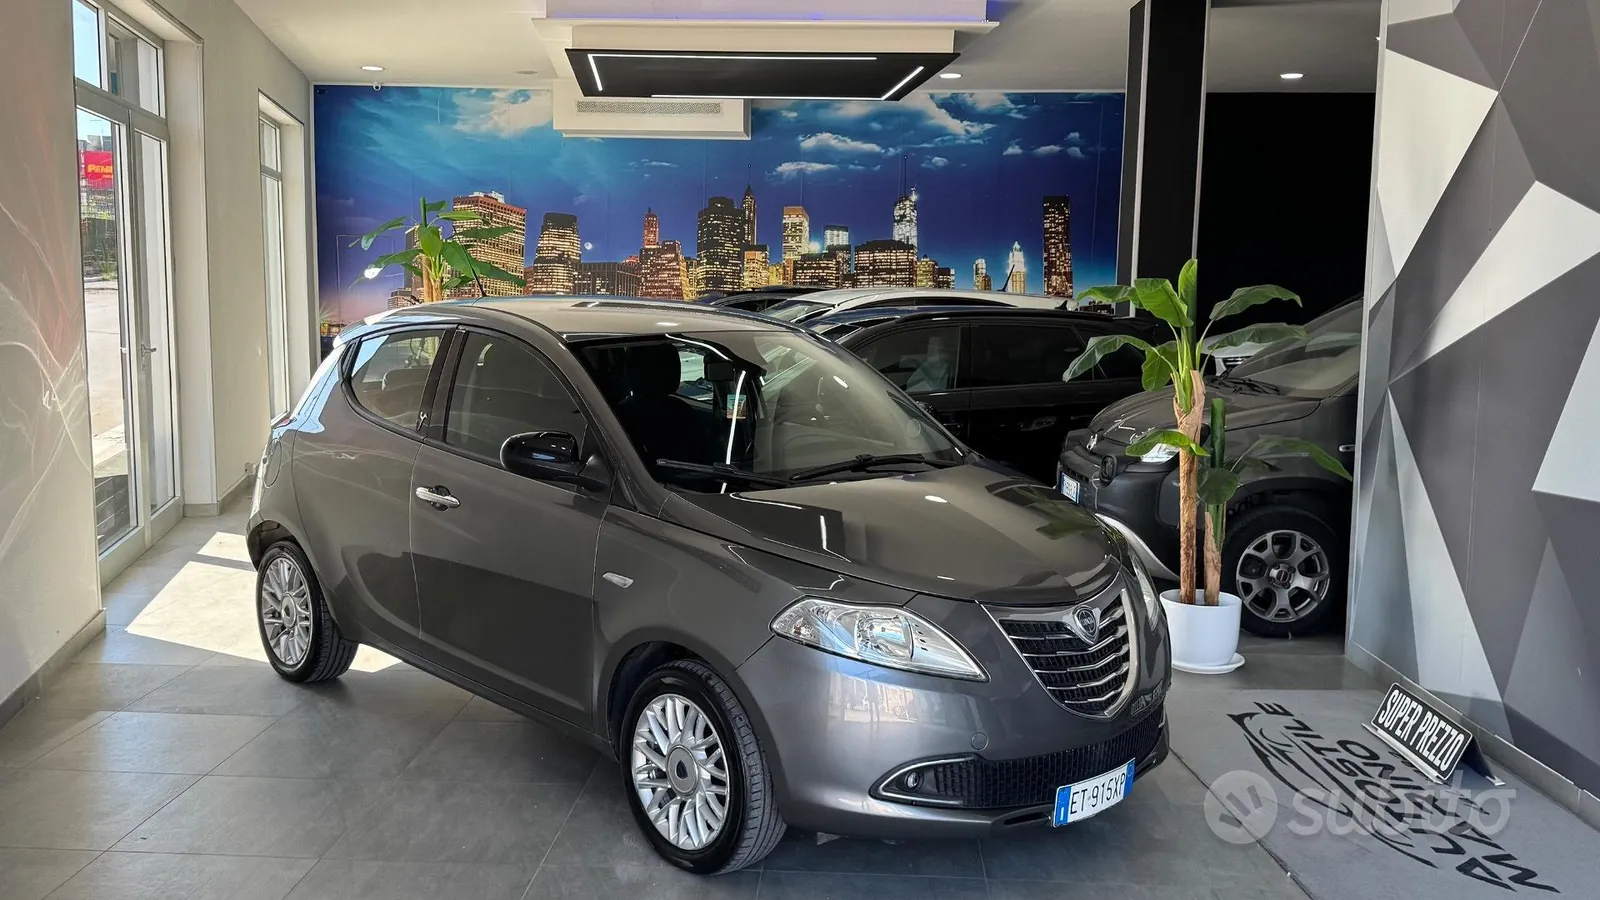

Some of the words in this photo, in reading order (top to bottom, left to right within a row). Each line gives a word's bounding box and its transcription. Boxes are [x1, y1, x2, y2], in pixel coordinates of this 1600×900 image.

[1253, 701, 1518, 892] AUTOSTILE
[1378, 689, 1423, 742] SUPER
[1409, 710, 1465, 772] PREZZO
[1336, 739, 1562, 894] MARINO
